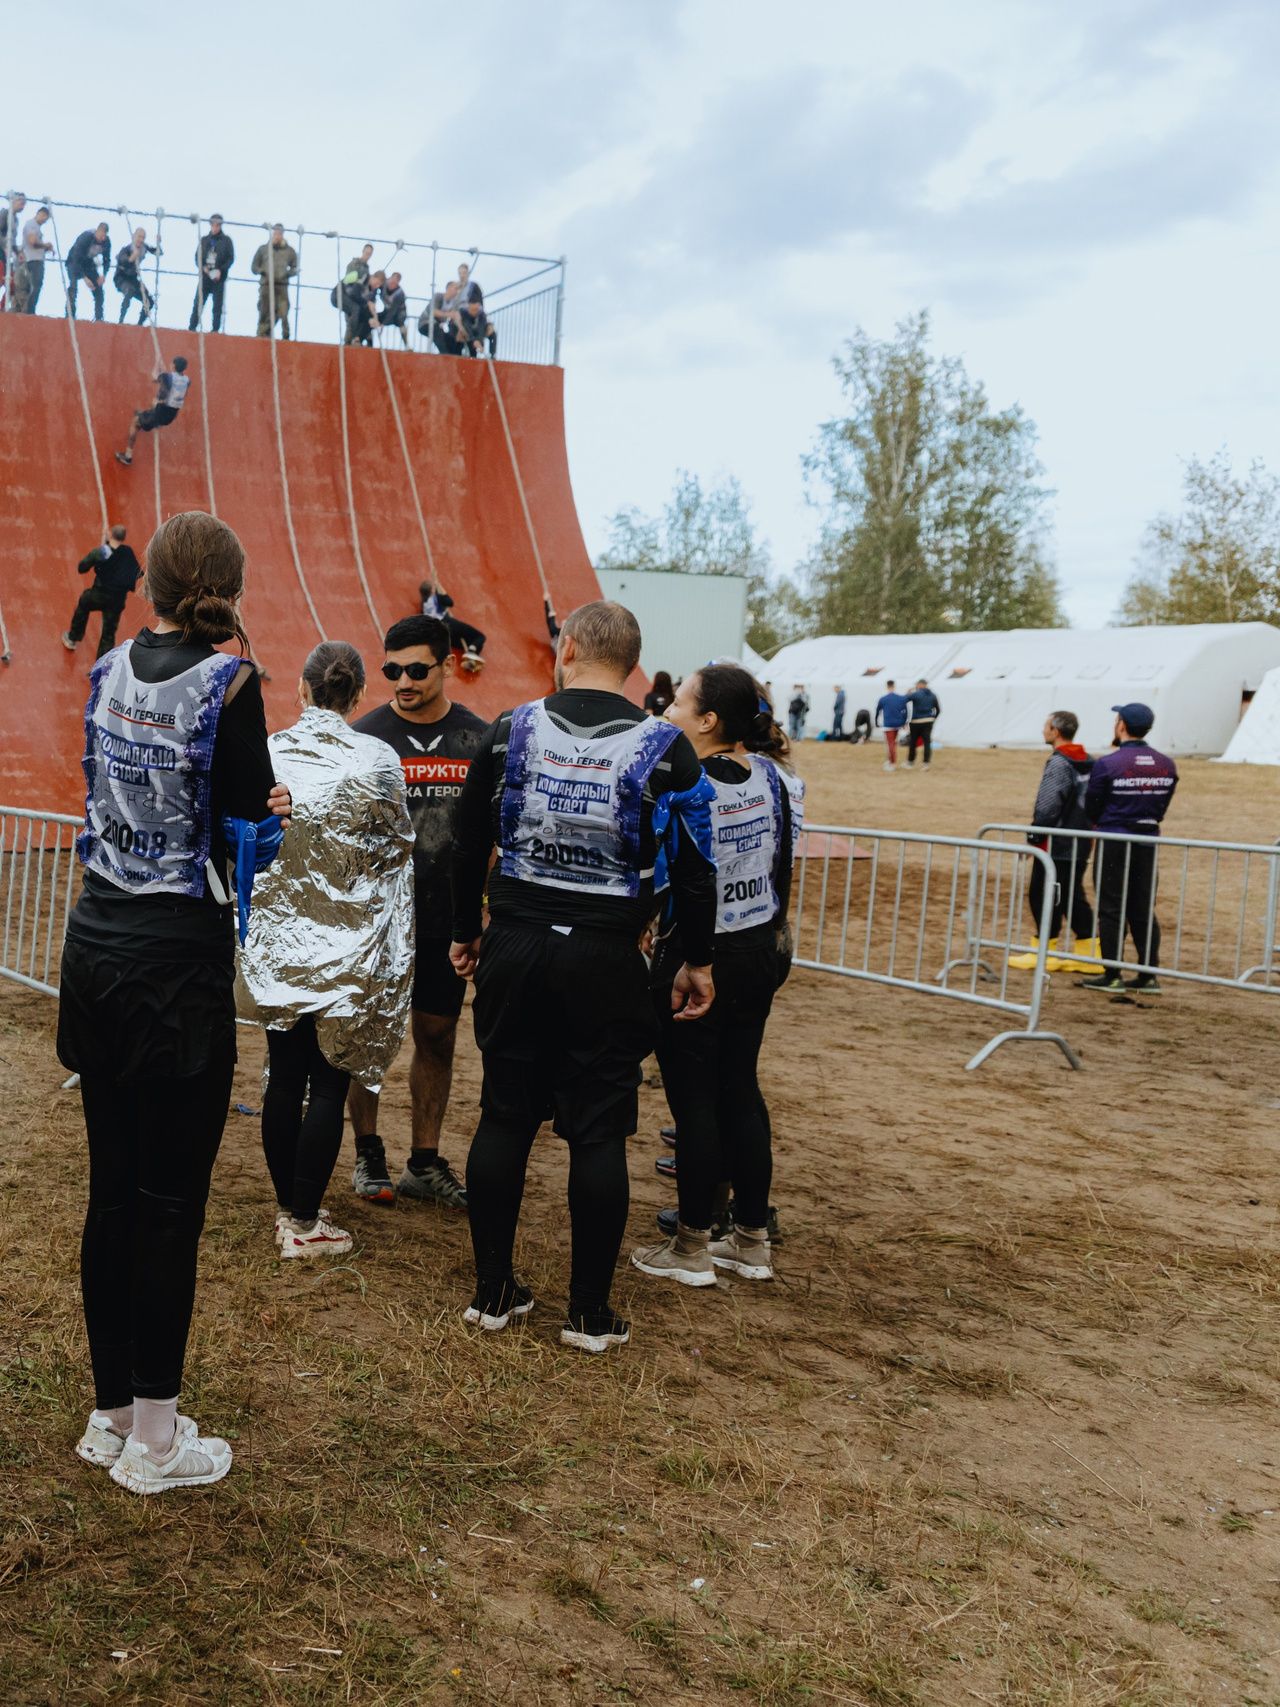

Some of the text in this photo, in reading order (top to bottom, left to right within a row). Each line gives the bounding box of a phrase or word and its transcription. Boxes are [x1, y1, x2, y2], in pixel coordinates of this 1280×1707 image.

[133, 709, 176, 725] ГЕРОЕВ
[543, 749, 613, 768] ГОНКА ГЕРОЕВ
[109, 761, 146, 784] СТАРТ
[426, 786, 464, 798] ГЕРО
[537, 776, 610, 801] КОМАНДНЫЙ
[549, 796, 586, 814] СТАРТ
[717, 794, 766, 813] ГОНКА ГЕРОЕВ
[100, 813, 168, 859] 20008
[738, 835, 761, 852] СТАРТ
[530, 837, 604, 868] 20009
[723, 874, 769, 904] 20001
